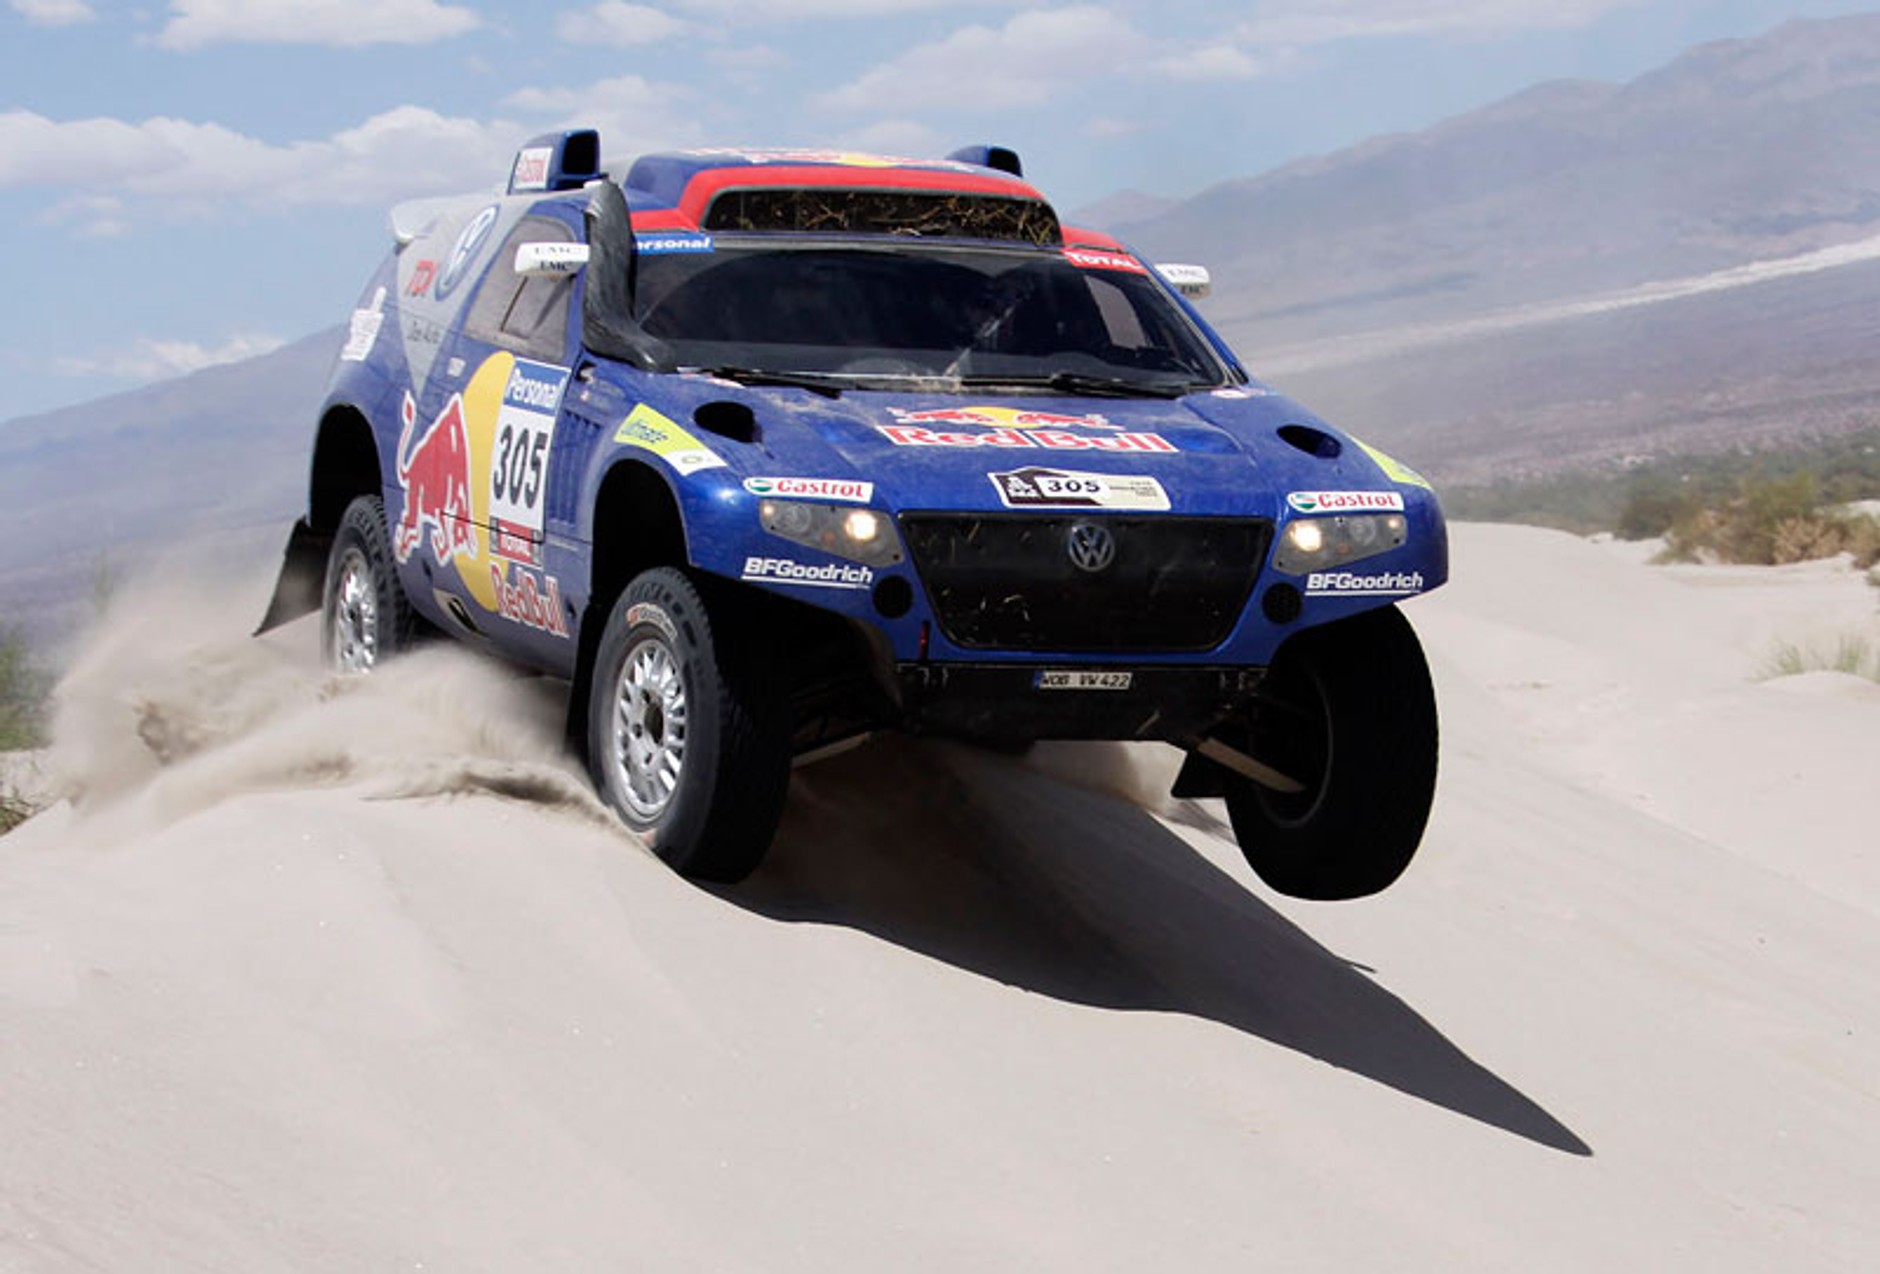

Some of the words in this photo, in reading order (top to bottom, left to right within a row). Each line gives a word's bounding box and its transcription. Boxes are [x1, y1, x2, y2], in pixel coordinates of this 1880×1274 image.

[504, 367, 567, 411] Personal
[879, 425, 1037, 448] Red
[1023, 430, 1178, 452] Bull
[494, 424, 548, 509] 305
[777, 480, 864, 498] Castrol
[1048, 480, 1101, 493] 305
[1318, 493, 1398, 509] Castrol
[743, 557, 873, 584] BFGoodrich
[1306, 572, 1424, 590] BFGoodrich
[1100, 674, 1130, 688] 422
